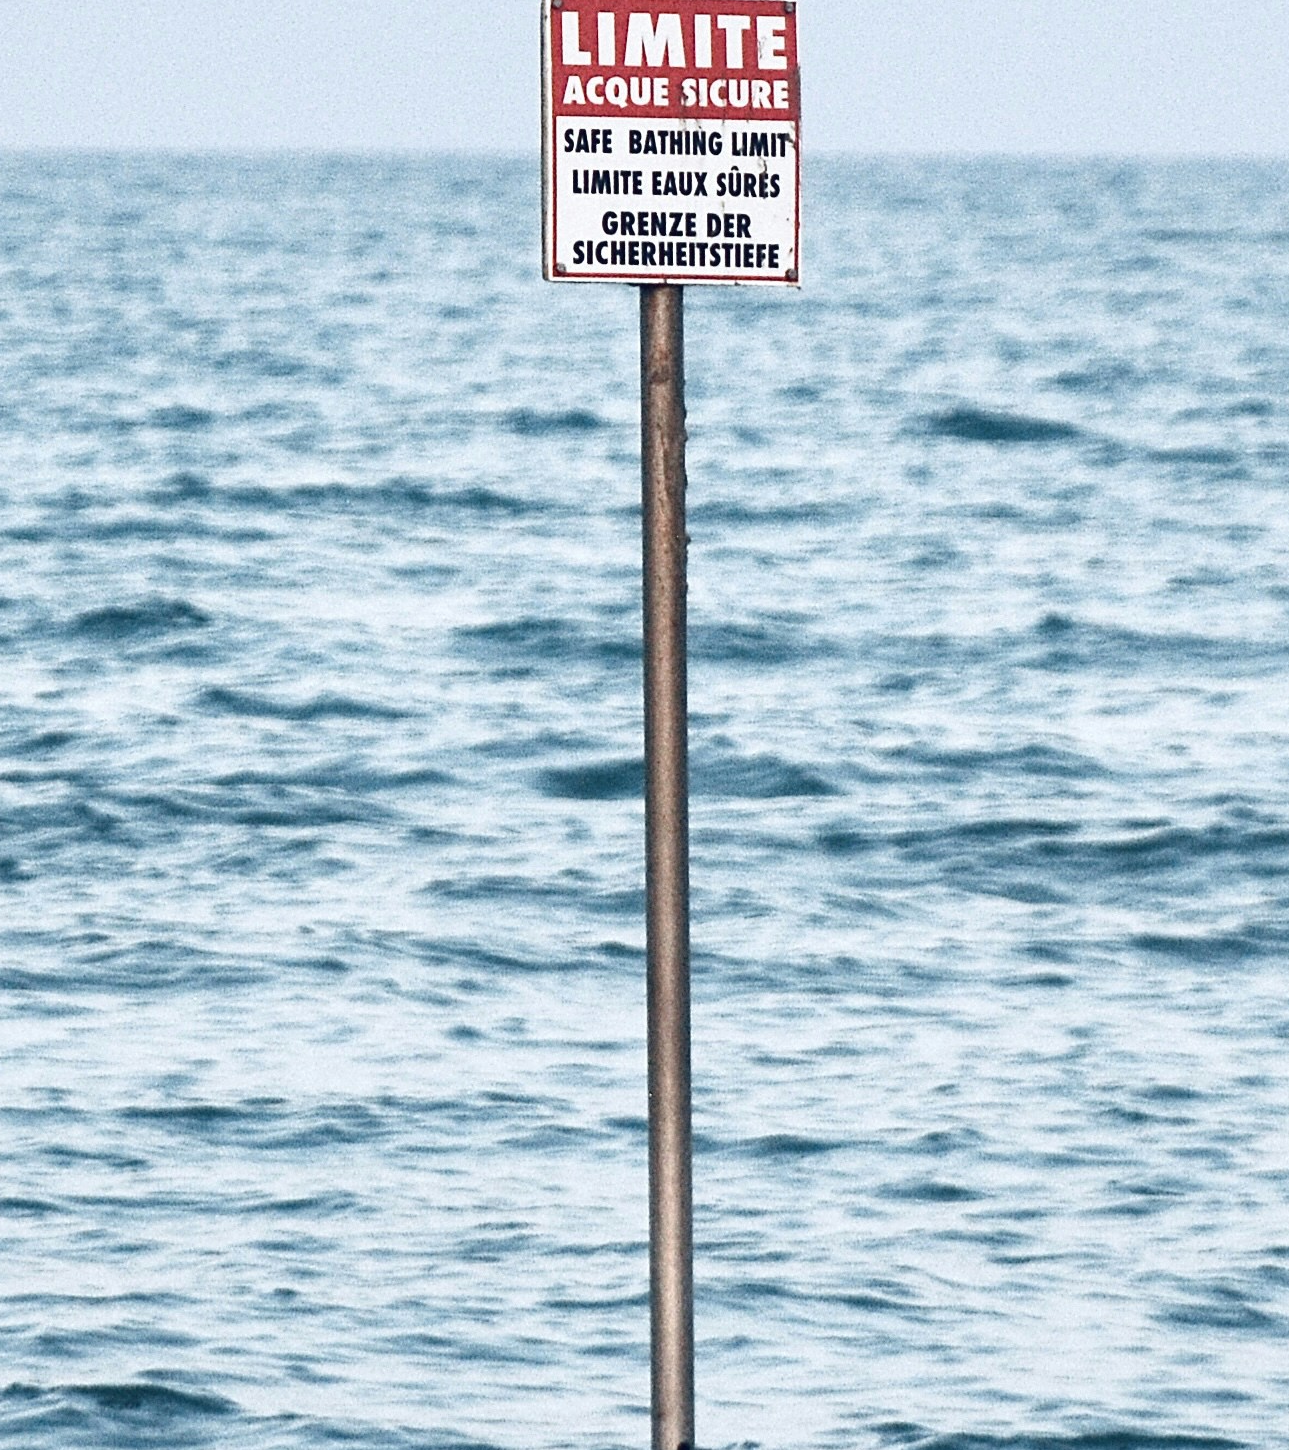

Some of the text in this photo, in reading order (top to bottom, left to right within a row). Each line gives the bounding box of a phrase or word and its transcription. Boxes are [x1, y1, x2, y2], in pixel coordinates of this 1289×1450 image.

[561, 11, 787, 70] LIMITE
[563, 75, 789, 109] ACQUE SICURE
[564, 128, 788, 157] SAFE BATHING LIMIT
[572, 166, 781, 198] LIMITE EAUX SÛRES
[602, 211, 751, 238] GRENZE DER
[573, 240, 779, 268] SICHERHEITSTIEFE
